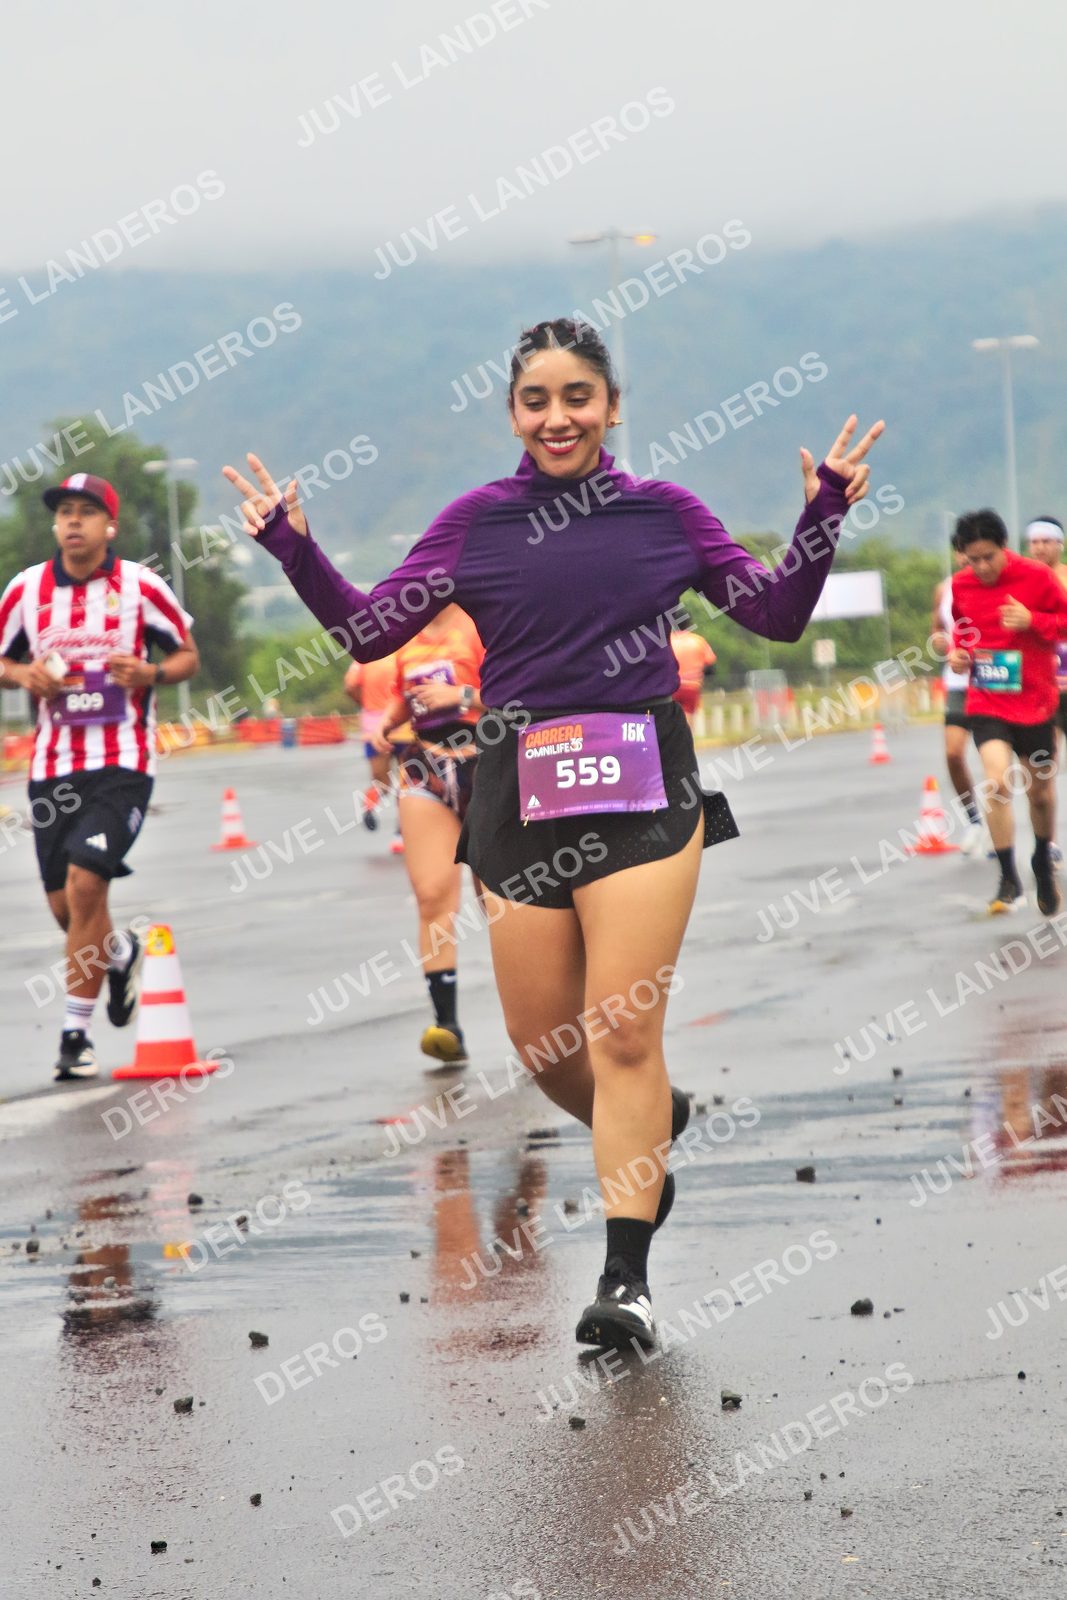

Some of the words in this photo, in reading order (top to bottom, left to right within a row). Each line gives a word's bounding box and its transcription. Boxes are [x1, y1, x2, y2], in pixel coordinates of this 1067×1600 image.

[66, 692, 104, 713] 809
[525, 724, 583, 749] CARRERA
[525, 741, 570, 759] OMNILIFE
[556, 755, 621, 789] 559
